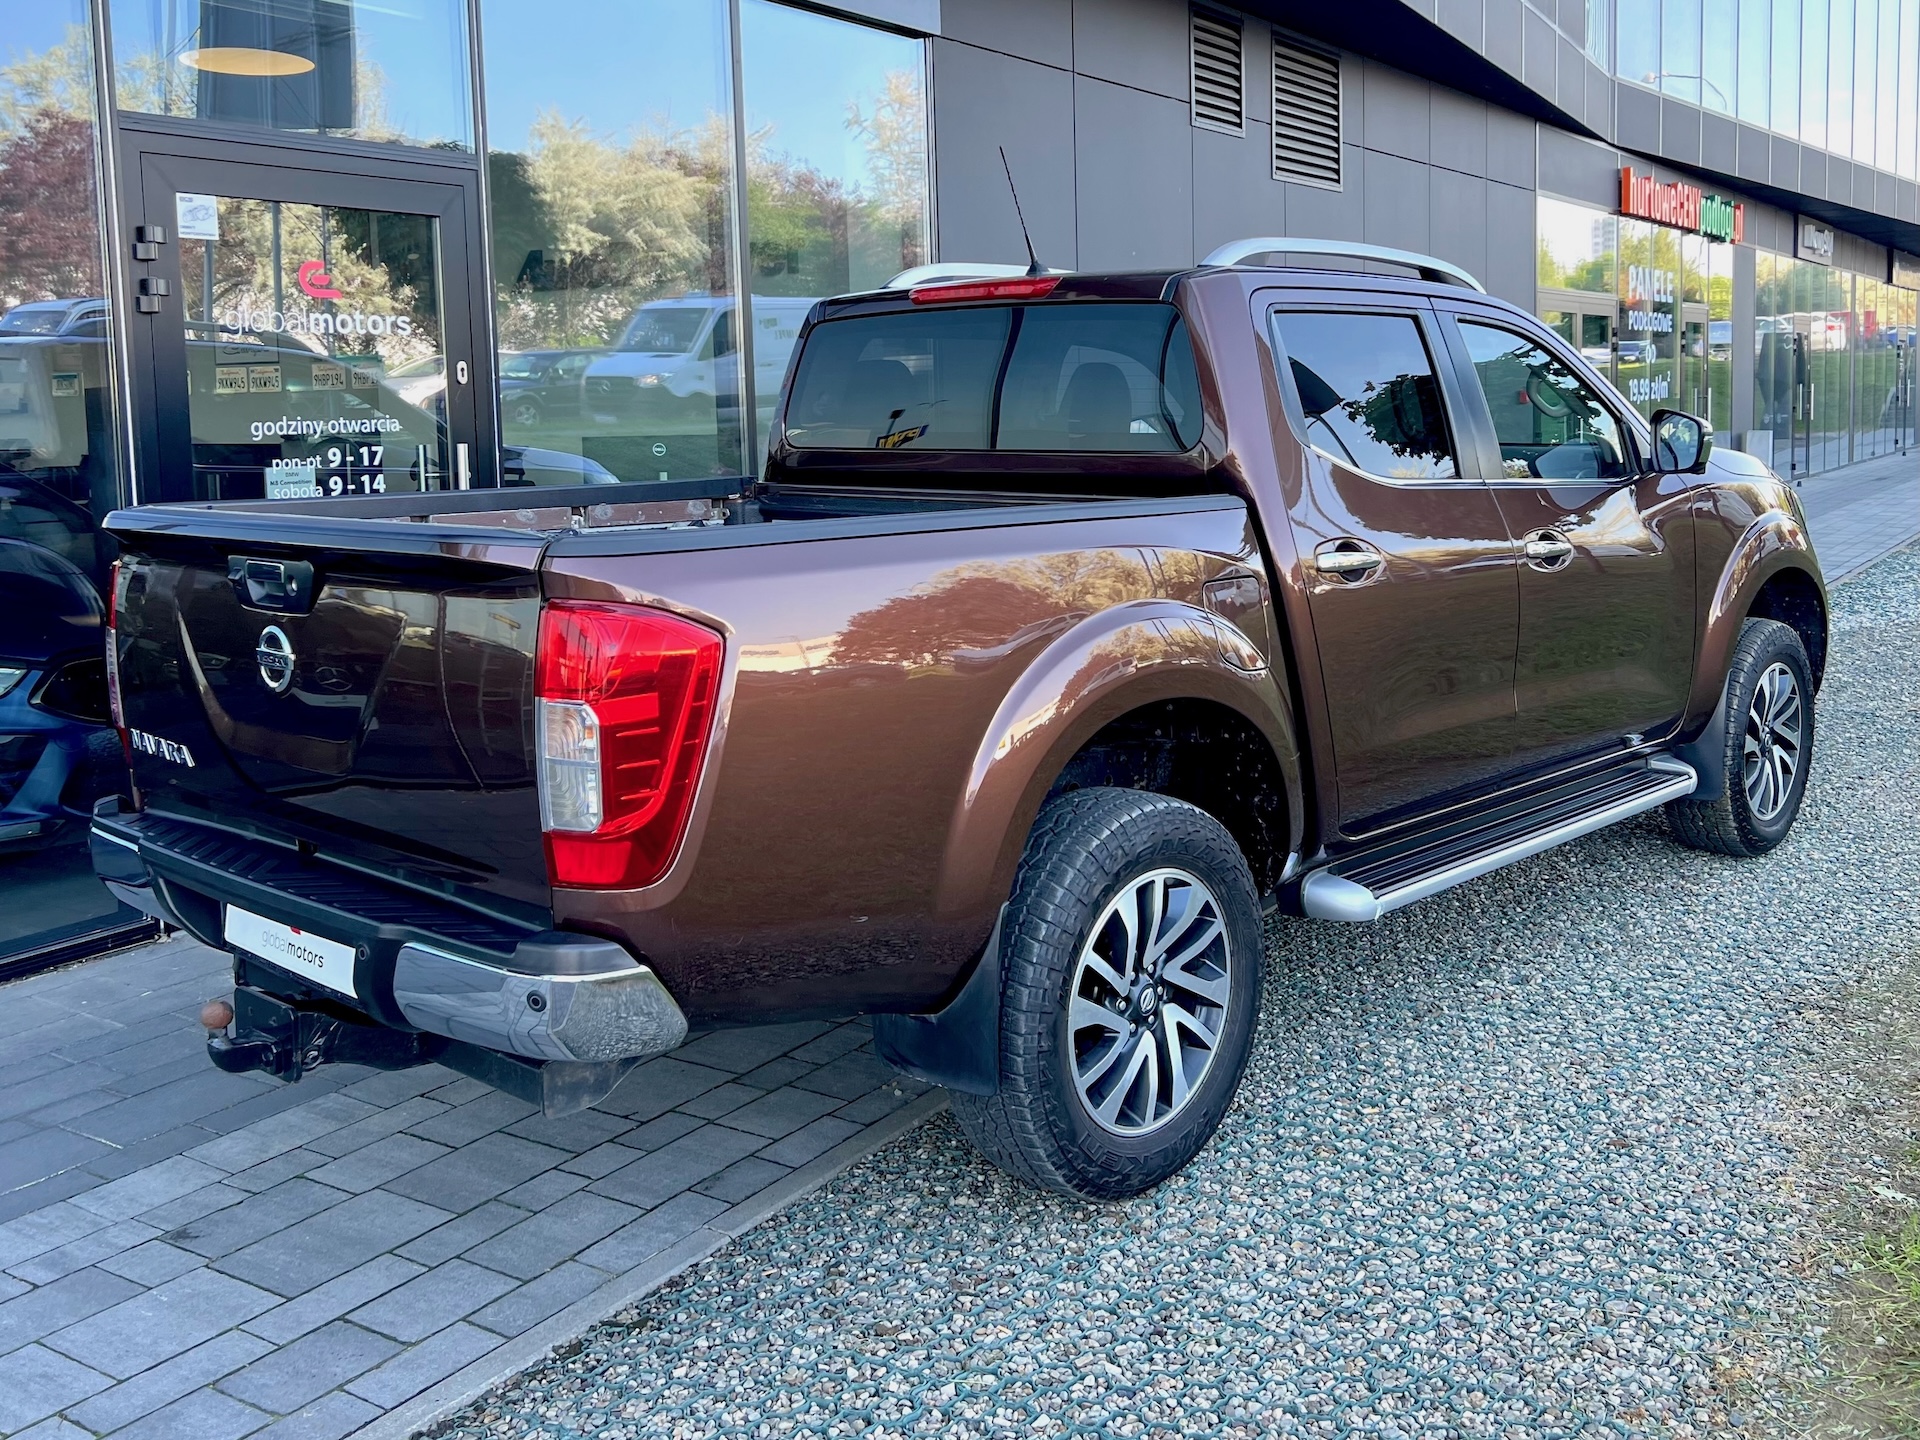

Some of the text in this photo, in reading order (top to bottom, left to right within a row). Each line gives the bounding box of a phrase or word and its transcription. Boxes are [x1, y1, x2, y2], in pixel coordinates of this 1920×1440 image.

[1628, 264, 1674, 304] PANELE
[225, 304, 411, 338] globalmotors
[1629, 378, 1650, 405] 19,99
[251, 415, 400, 441] godziny otwarcia
[272, 455, 322, 473] pon-pt
[327, 447, 342, 468] 9
[359, 446, 384, 467] 17
[274, 484, 323, 499] sobota
[329, 476, 343, 496] 9
[361, 474, 386, 494] 14
[130, 728, 195, 767] NAVARA
[261, 929, 324, 968] globalmotors
